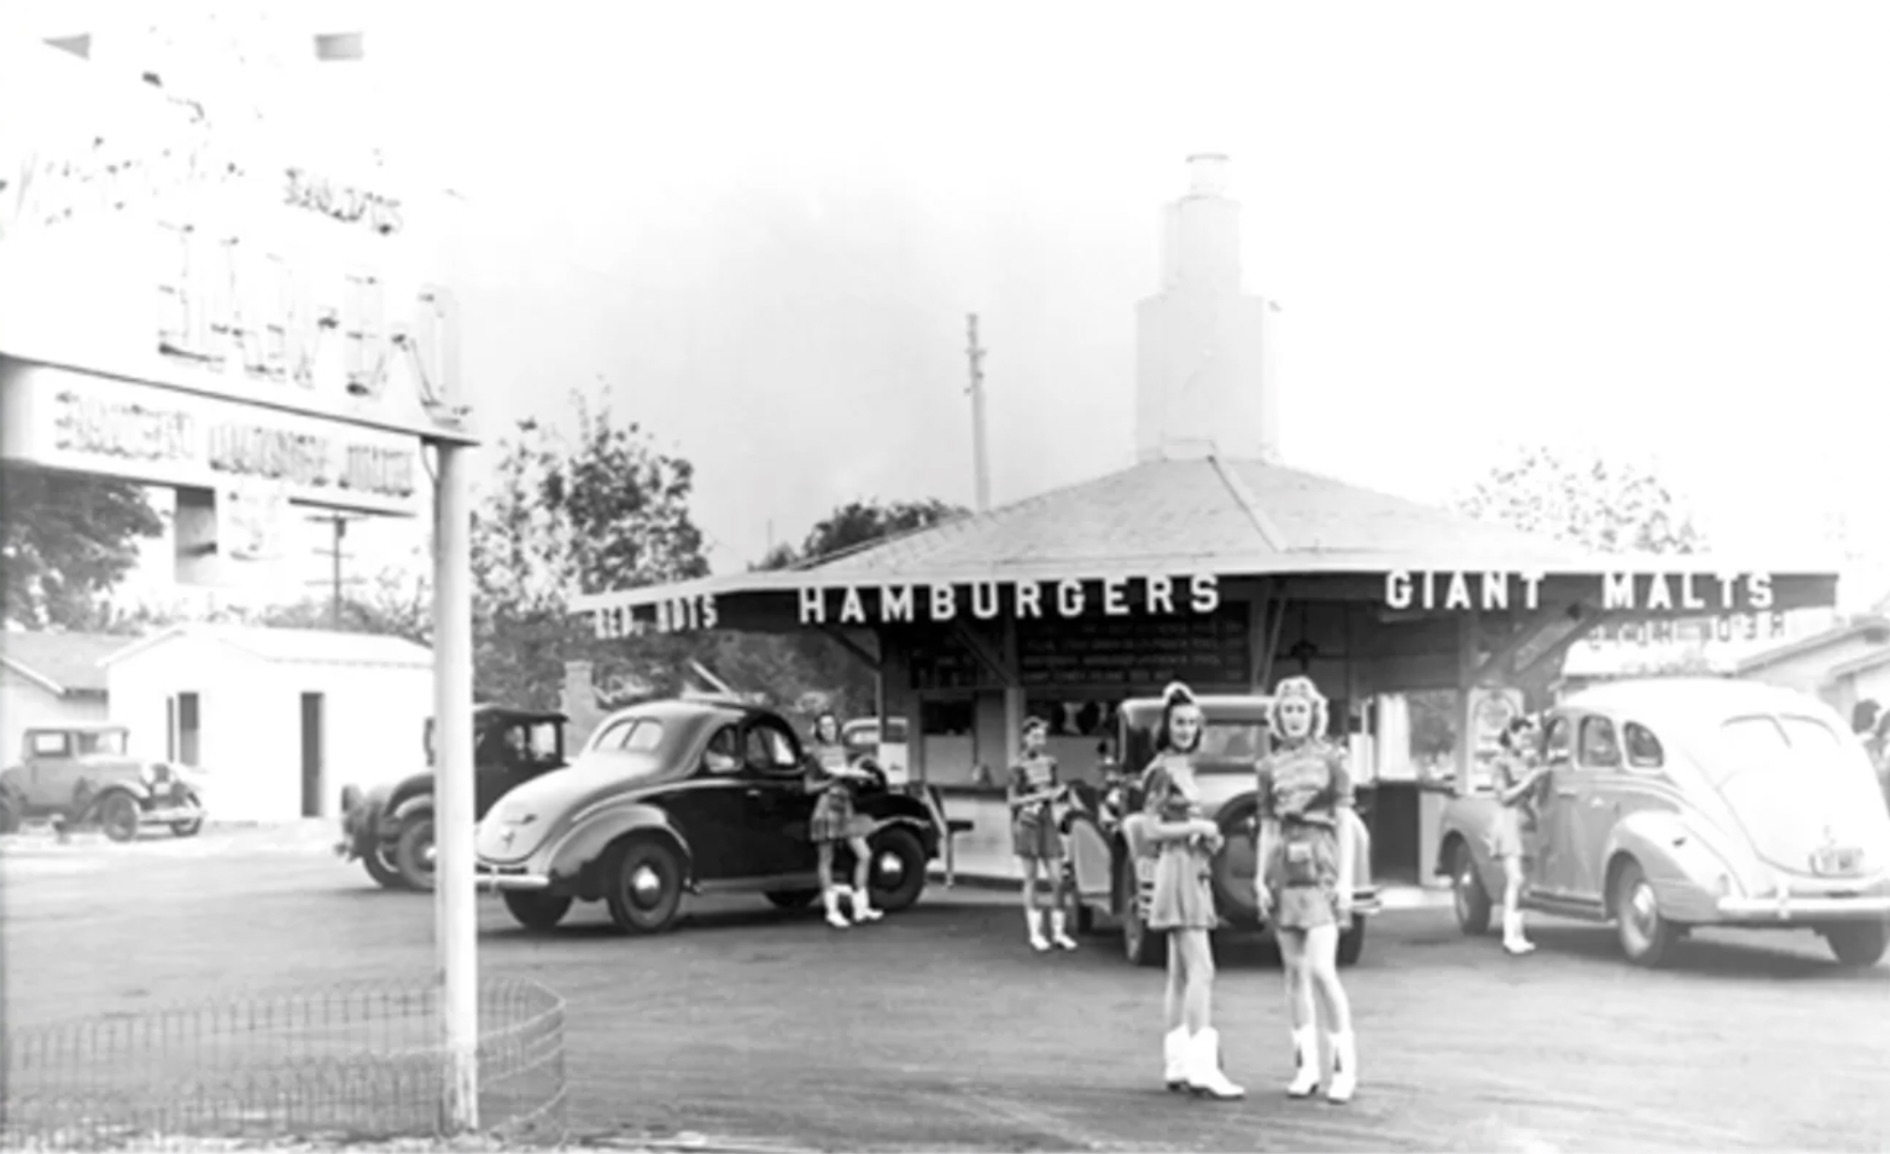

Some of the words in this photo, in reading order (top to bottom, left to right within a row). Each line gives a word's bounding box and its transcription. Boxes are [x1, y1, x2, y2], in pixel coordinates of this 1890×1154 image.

[799, 573, 1220, 623] HAMBURGERS
[1385, 570, 1546, 609] GIANT
[1603, 571, 1774, 609] MALTS
